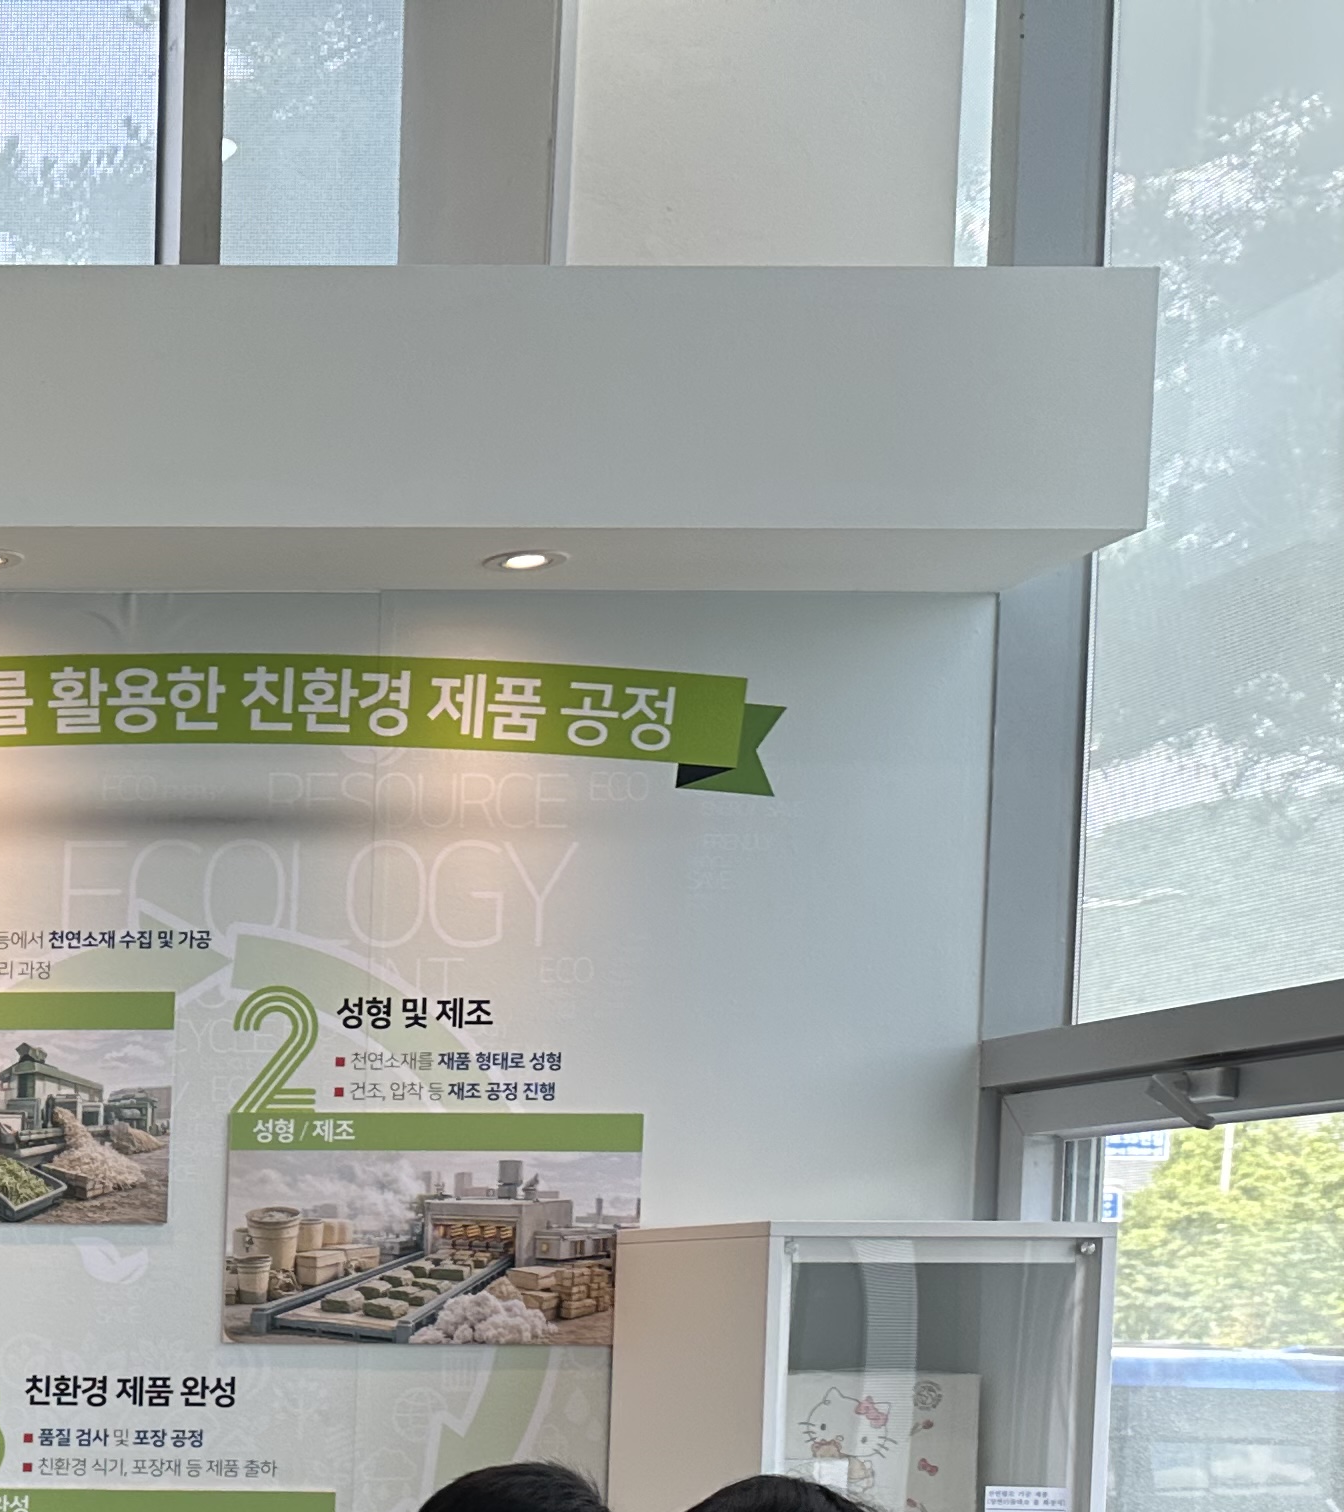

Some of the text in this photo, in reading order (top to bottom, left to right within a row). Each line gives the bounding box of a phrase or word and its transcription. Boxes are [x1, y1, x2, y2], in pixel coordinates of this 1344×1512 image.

[48, 666, 226, 734] 활용한
[242, 668, 411, 736] 친환경
[427, 674, 546, 741] 제품
[560, 682, 675, 751] 공정
[267, 771, 569, 829] RESOURCE
[61, 839, 579, 949] ECOLOGY
[49, 930, 115, 949] 천연소재
[119, 930, 152, 949] 수집
[158, 930, 173, 948] 및
[179, 930, 212, 949] 가공
[18, 961, 51, 980] 과정
[337, 997, 493, 1029] 성형 및 제조
[233, 985, 318, 1113] 2
[351, 1052, 561, 1071] 천연소재를 형태로 성형
[350, 1082, 555, 1101] 건조, 압착 등 공정 진행
[253, 1119, 355, 1143] 성형 제조
[25, 1375, 235, 1408] 친환경 제품 완성
[38, 1428, 203, 1448] 품질 검사 및 포장 공정
[38, 1458, 277, 1478] 친환경 식기, 포장재 등 제품 출하
